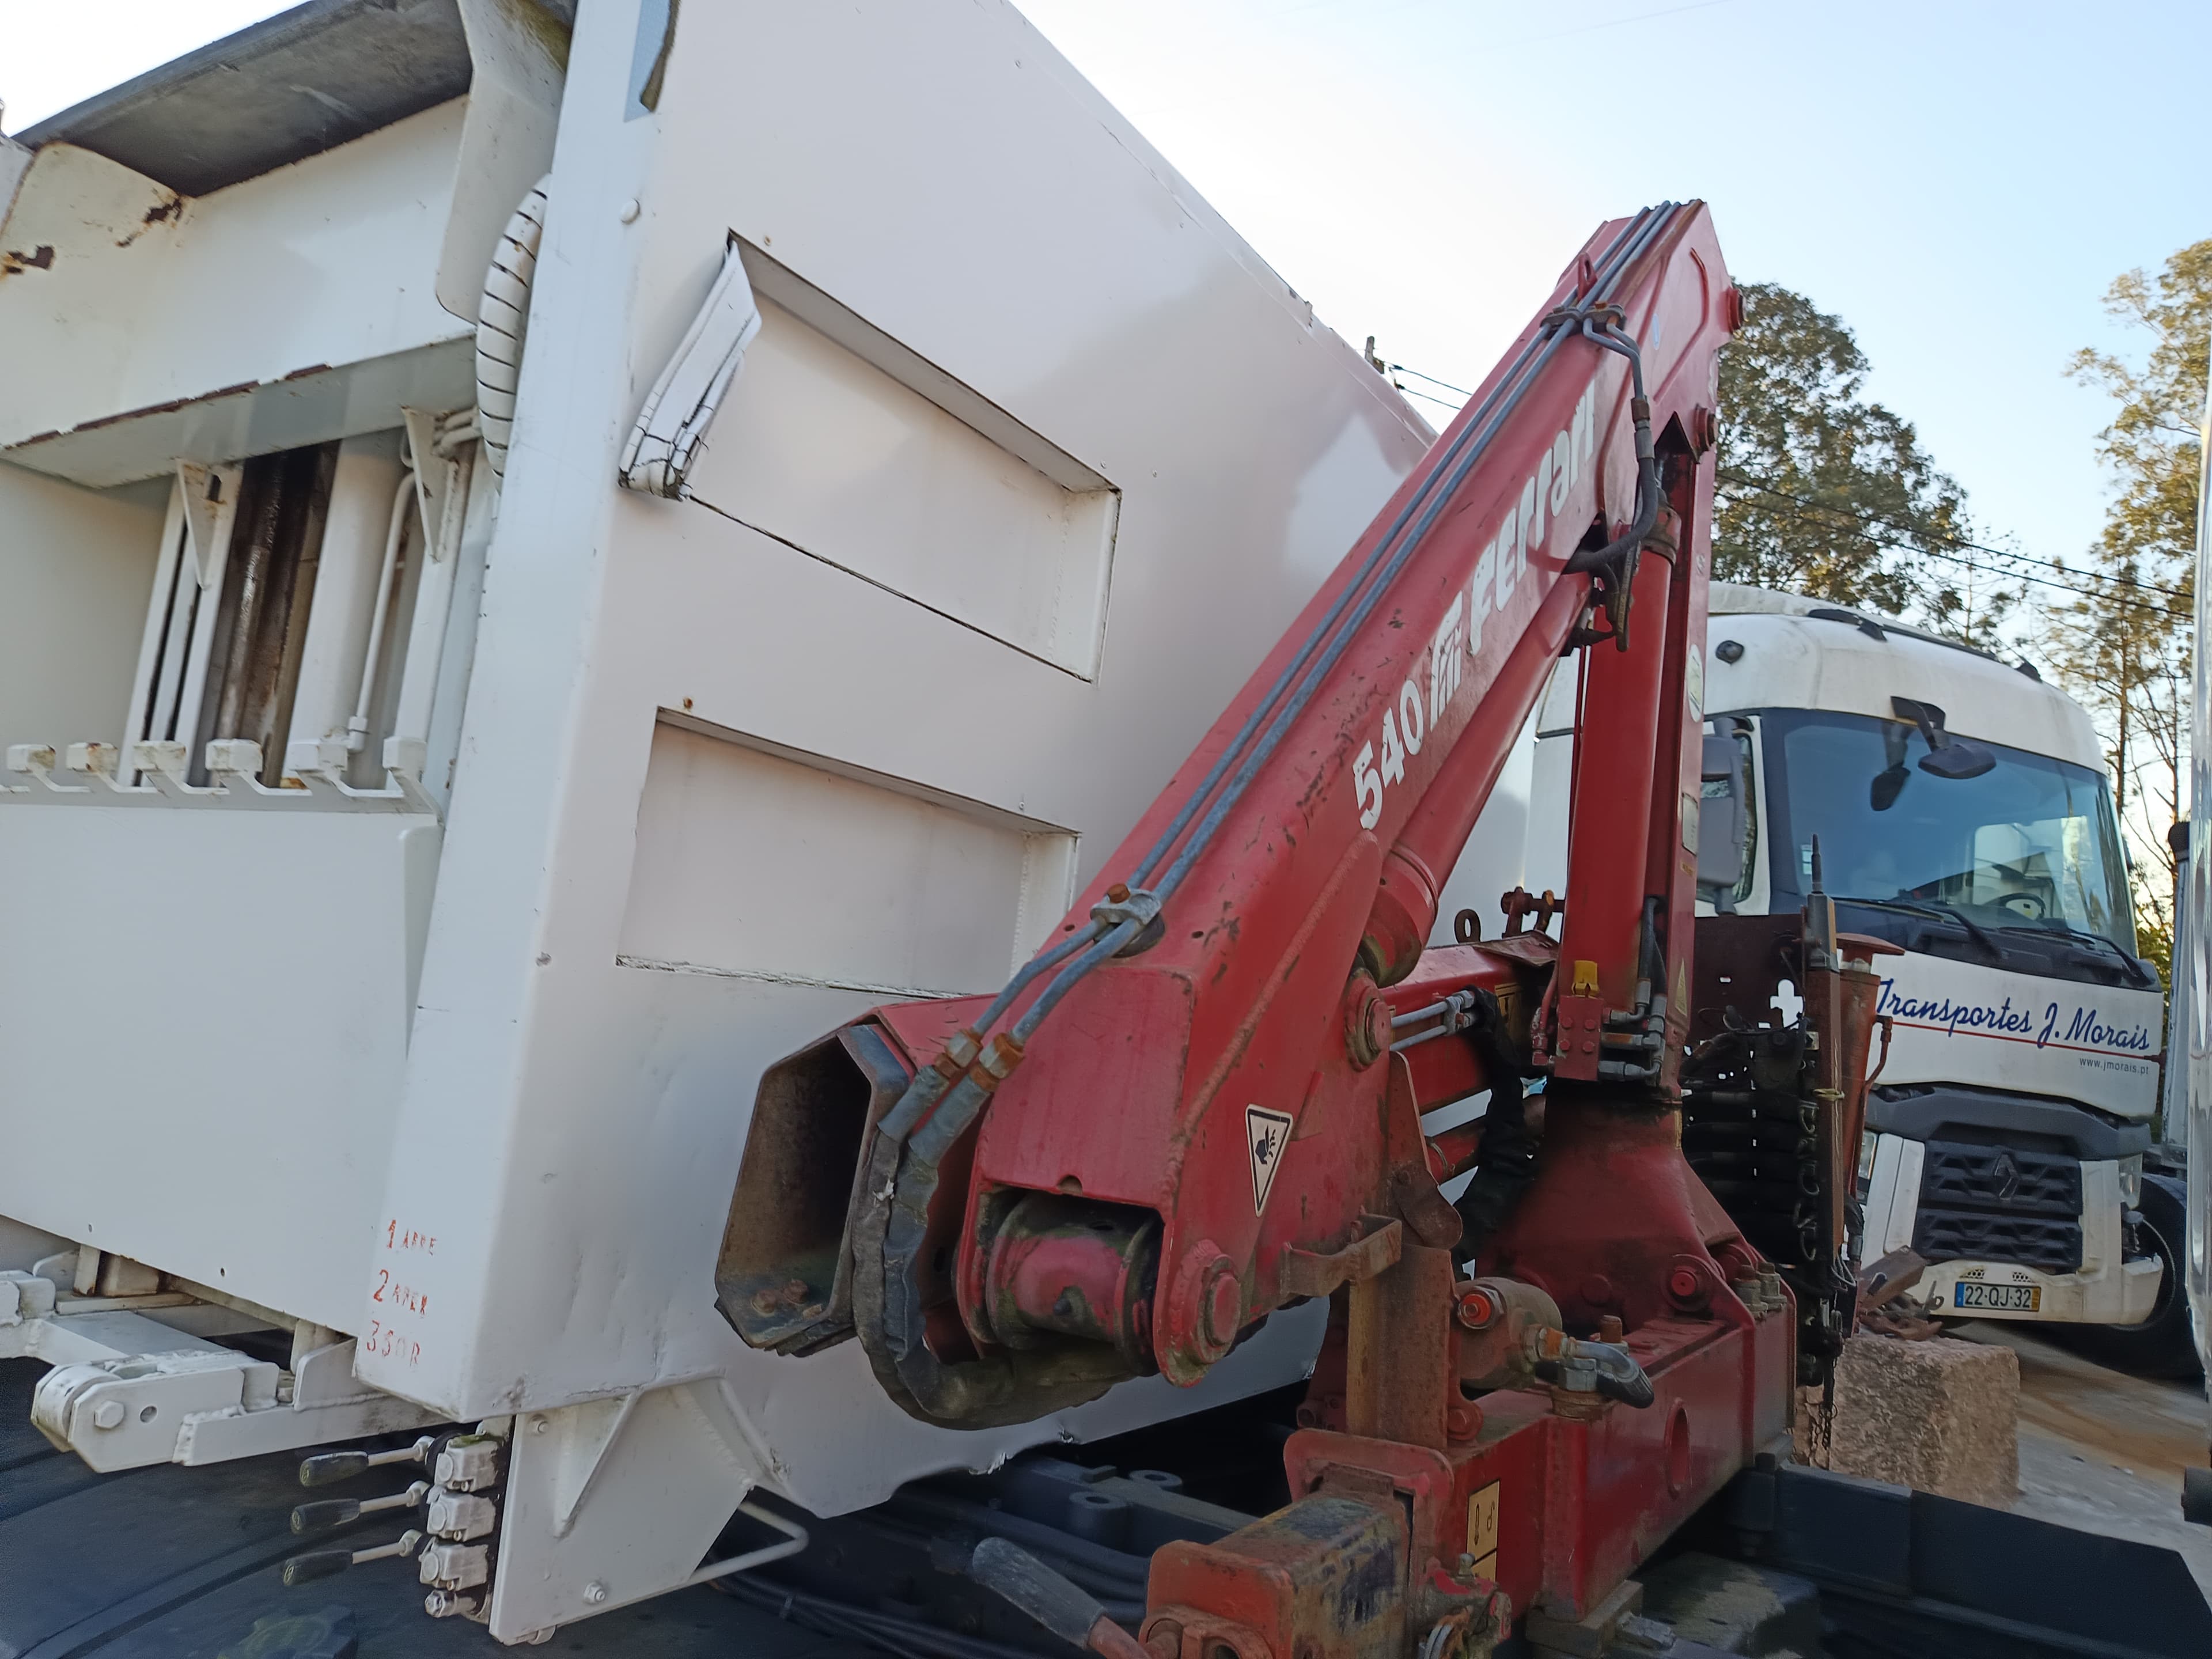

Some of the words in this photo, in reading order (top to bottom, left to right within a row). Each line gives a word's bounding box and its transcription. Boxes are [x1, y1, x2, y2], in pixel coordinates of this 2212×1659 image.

[1353, 680, 1425, 831] 540
[1877, 978, 2032, 1037] Transportes
[2037, 1003, 2059, 1048] J.
[2065, 1007, 2150, 1050] Morais
[2080, 1058, 2149, 1075] www.jmorais.pt
[373, 1269, 389, 1302] 2
[367, 1320, 380, 1351] 3
